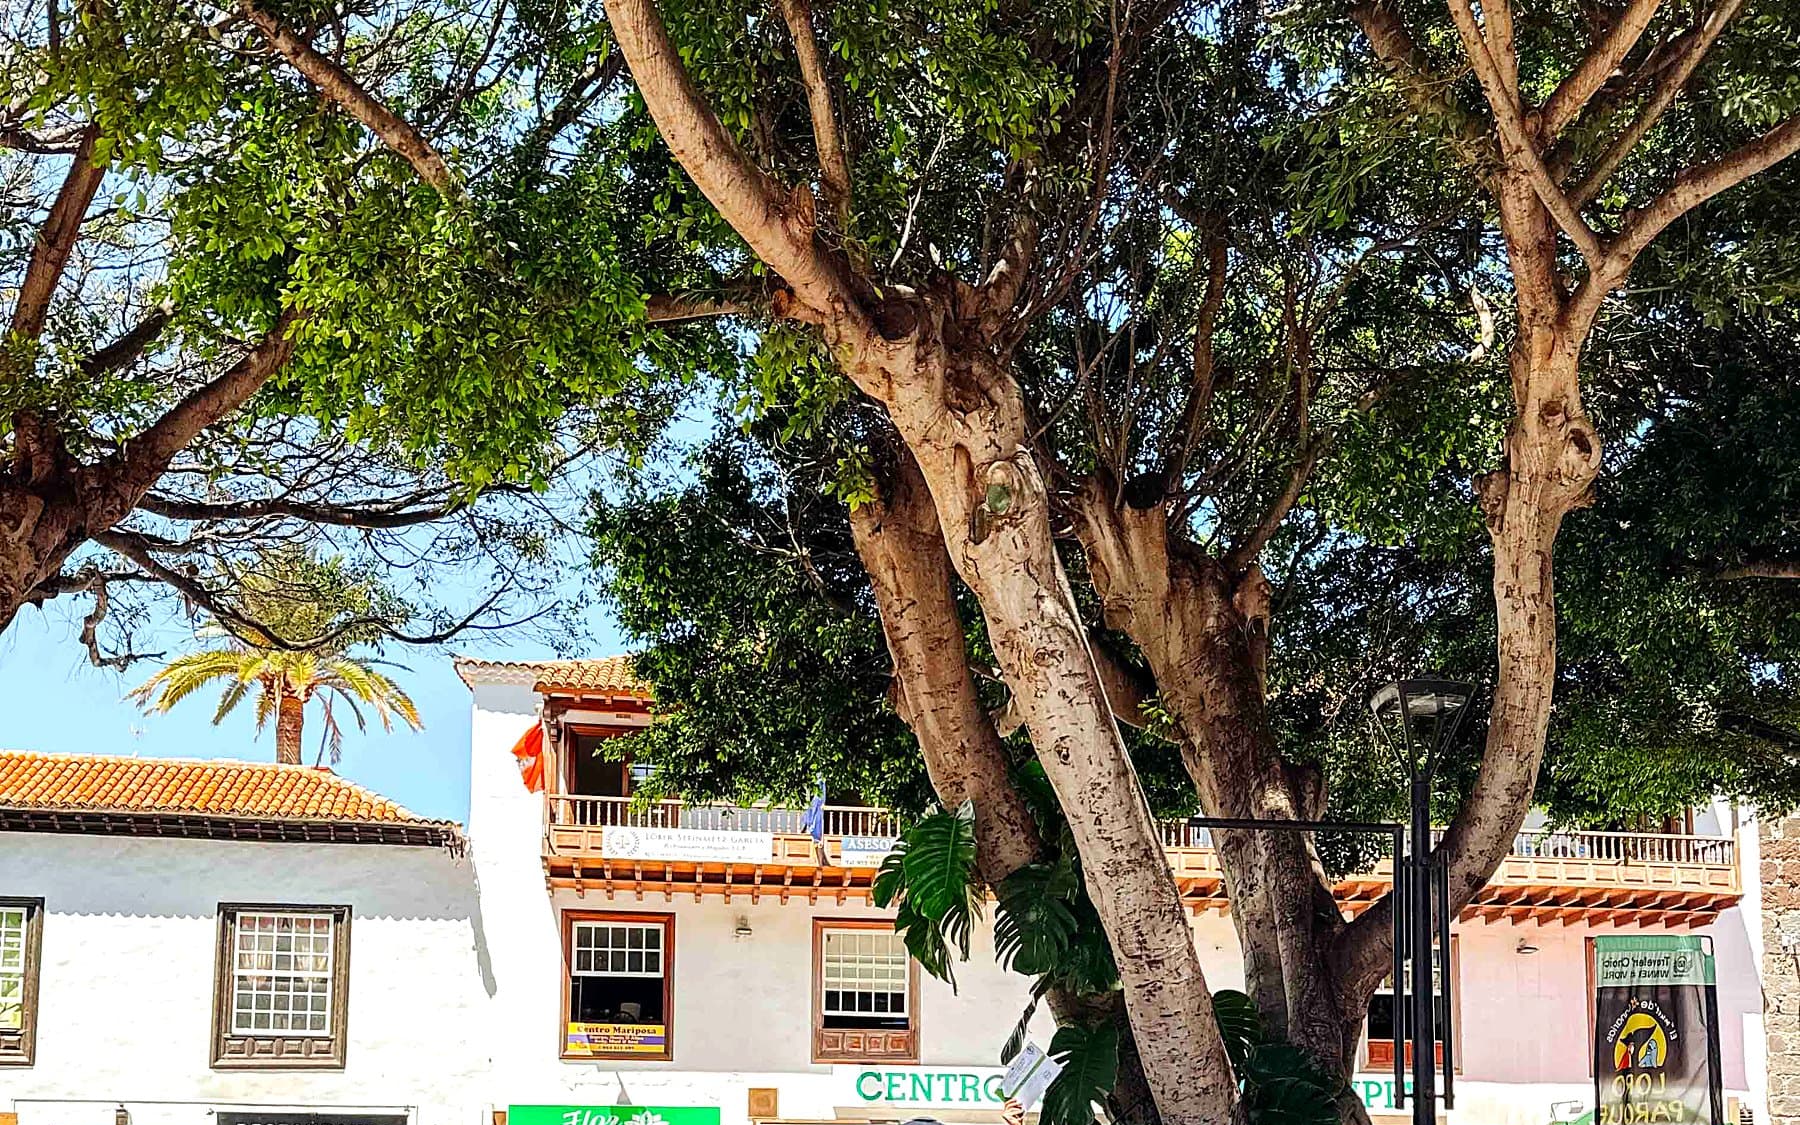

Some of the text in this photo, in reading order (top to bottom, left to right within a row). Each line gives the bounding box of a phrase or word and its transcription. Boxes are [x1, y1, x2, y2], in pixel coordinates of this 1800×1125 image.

[577, 1026, 657, 1035] Centro Mariposa
[856, 1071, 1005, 1103] CENTRO
